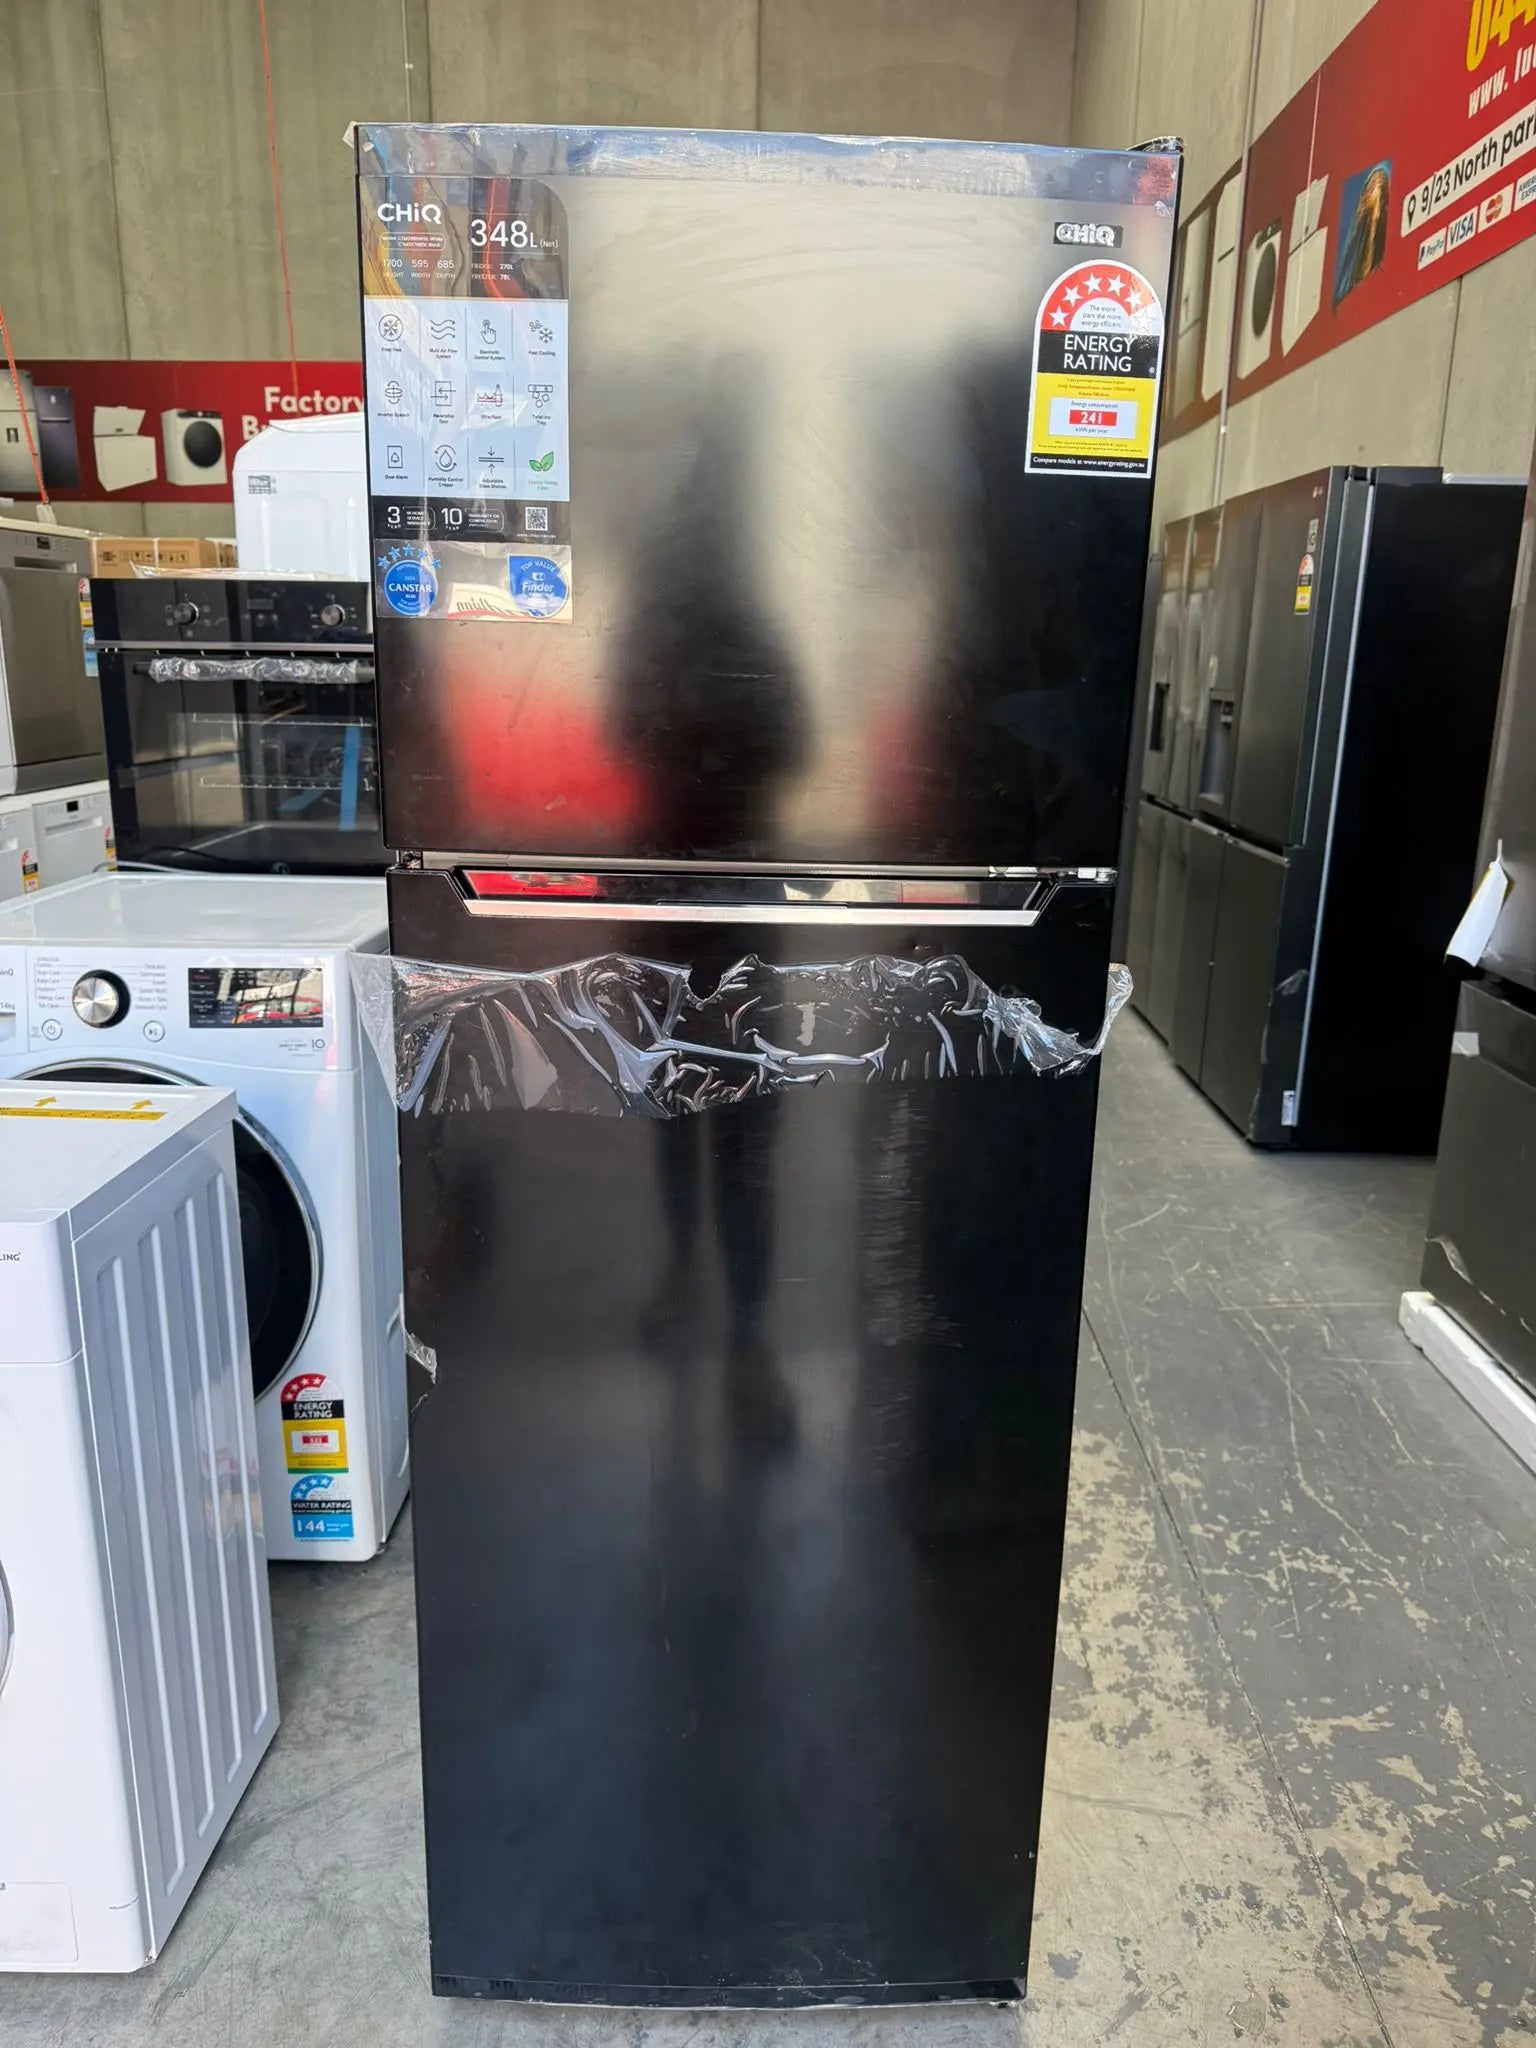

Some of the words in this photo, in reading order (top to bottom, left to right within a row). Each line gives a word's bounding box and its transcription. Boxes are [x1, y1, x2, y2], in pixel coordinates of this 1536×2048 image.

[1421, 168, 1451, 216] 9/23
[1454, 136, 1498, 191] North
[377, 203, 442, 225] CHiQ
[1449, 212, 1474, 247] VISA
[411, 259, 429, 268] 595
[1064, 334, 1136, 353] ENERGY
[1063, 352, 1132, 372] RATING
[1081, 411, 1103, 425] 241
[387, 506, 401, 524] 3
[441, 507, 463, 525] 10
[521, 561, 533, 571] TOP
[388, 583, 433, 593] CANSTAR
[522, 581, 555, 592] Finder
[294, 1401, 333, 1411] ENERGY
[294, 1410, 333, 1419] RATING
